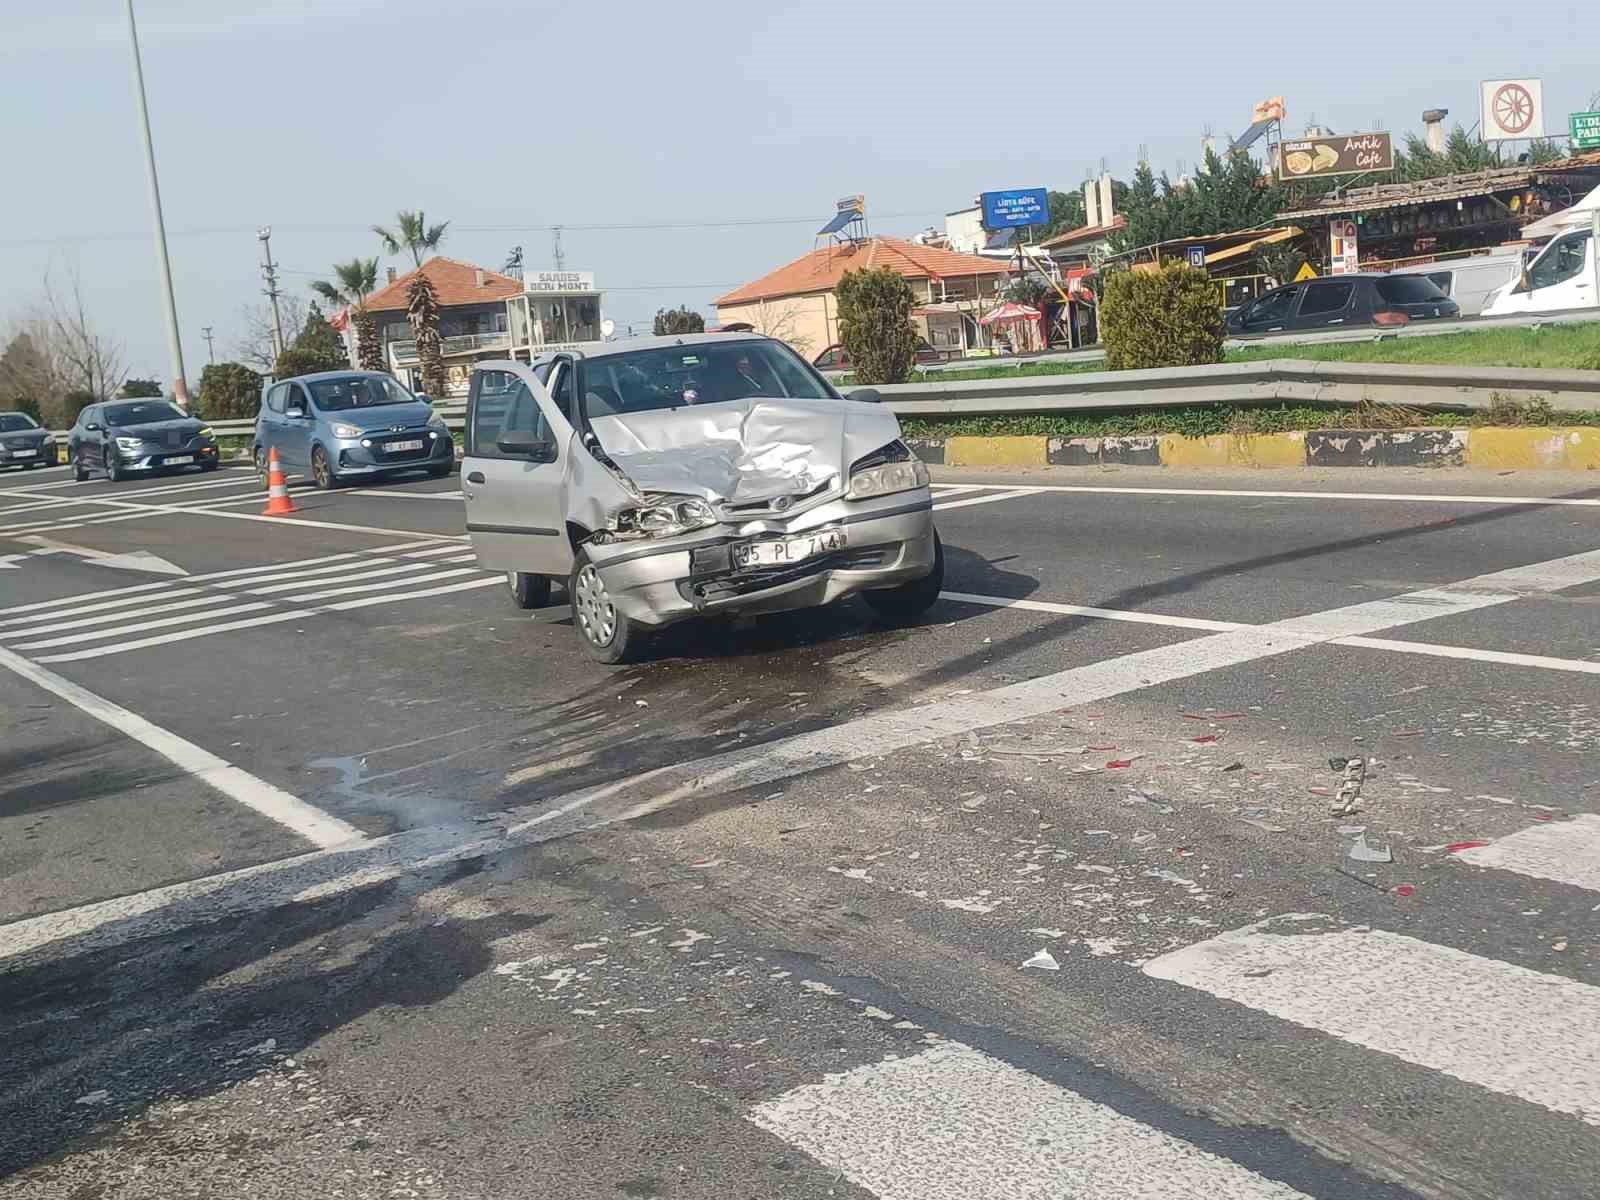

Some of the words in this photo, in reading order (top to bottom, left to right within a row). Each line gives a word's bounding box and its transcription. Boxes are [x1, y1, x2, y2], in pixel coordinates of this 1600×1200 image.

[1343, 136, 1381, 151] Antik
[1356, 150, 1383, 168] Cafe
[774, 542, 794, 561] PL
